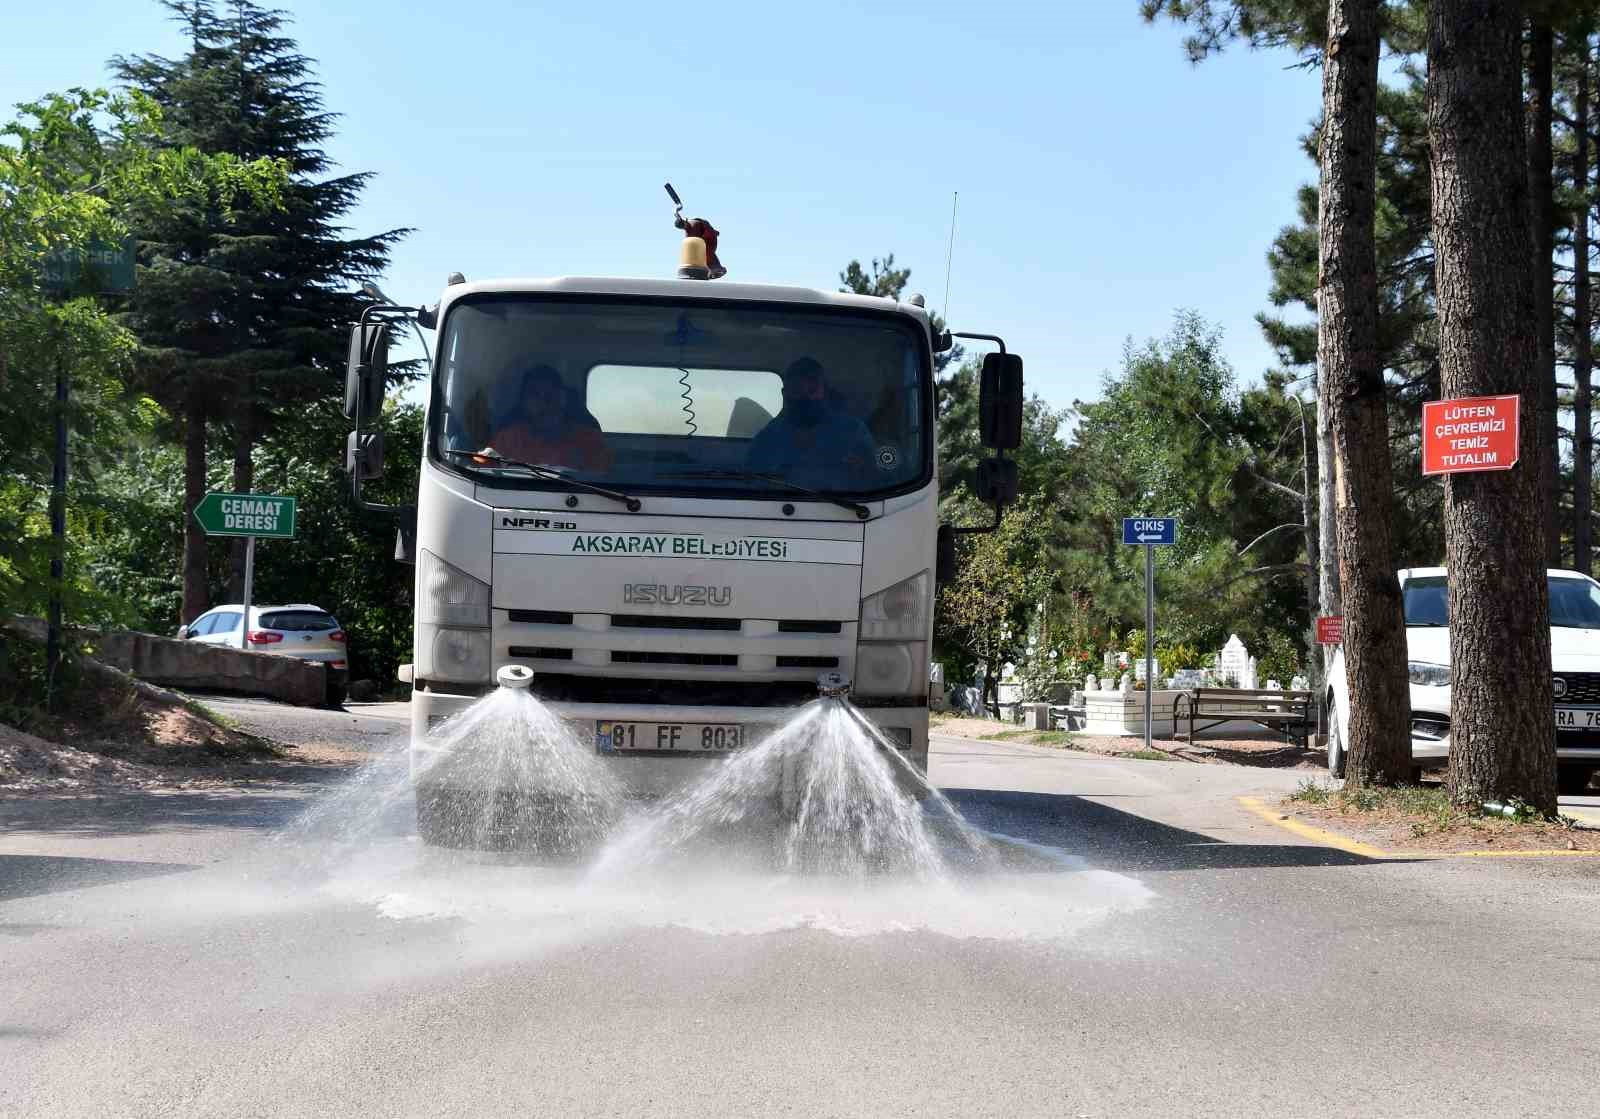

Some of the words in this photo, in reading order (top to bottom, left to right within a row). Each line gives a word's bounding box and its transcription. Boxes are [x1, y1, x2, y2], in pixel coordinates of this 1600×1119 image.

[1444, 405, 1495, 420] LÜTFEN
[1435, 418, 1505, 439] ÇEVREMİZİ
[1449, 435, 1489, 450] TEMİZ
[1441, 452, 1497, 466] TUTALIM
[221, 499, 284, 516] CEMAAT
[502, 517, 550, 529] NPR
[572, 535, 667, 554] AKSARAY
[623, 583, 732, 606] ISUZU
[613, 724, 635, 748] 81
[657, 725, 682, 749] FF
[701, 726, 738, 749] 803
